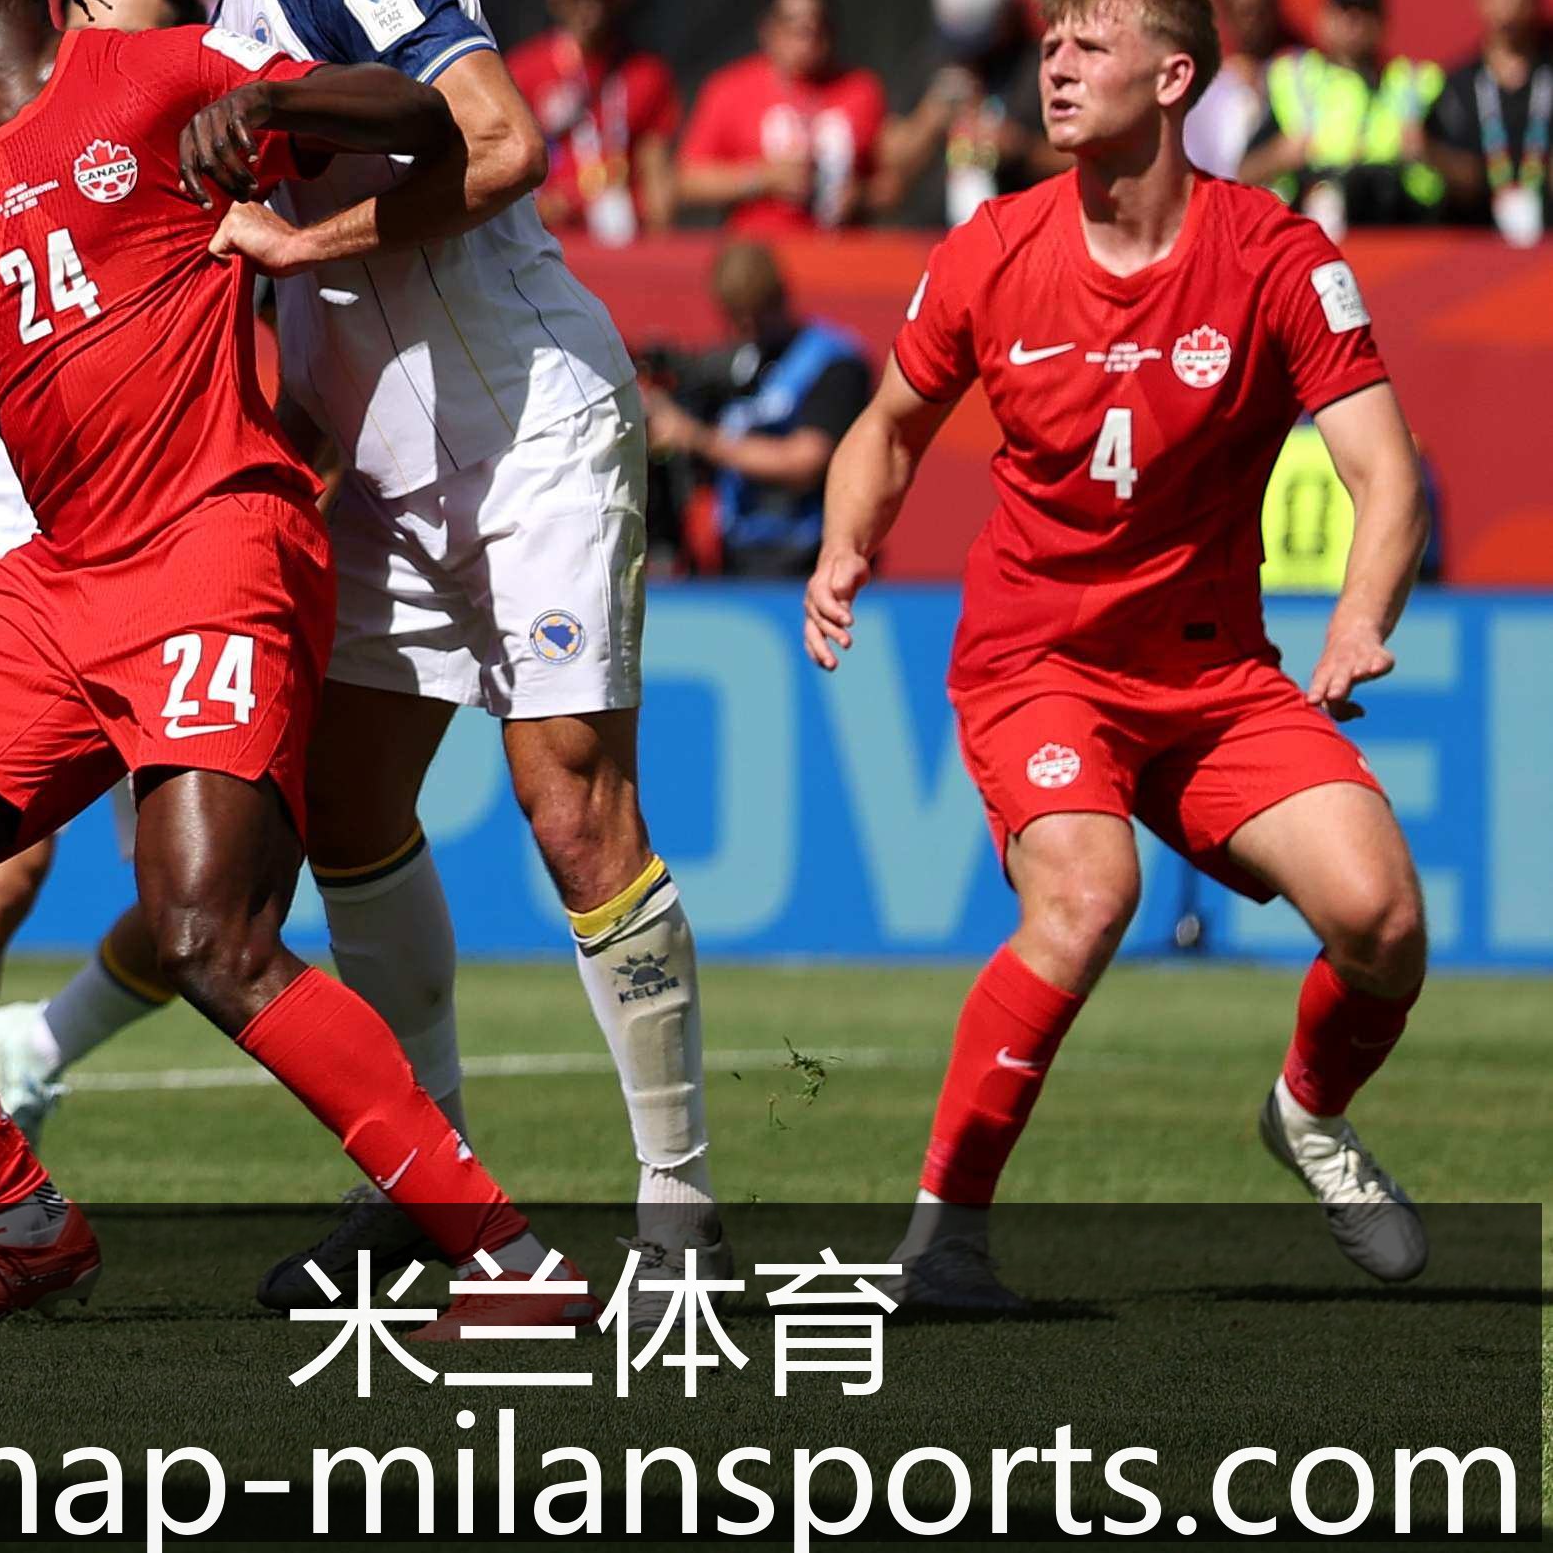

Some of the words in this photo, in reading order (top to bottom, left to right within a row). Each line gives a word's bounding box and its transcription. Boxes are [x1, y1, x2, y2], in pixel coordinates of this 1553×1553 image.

[77, 161, 136, 183] CANADA
[1089, 407, 1139, 500] 4
[160, 633, 256, 725] 24
[618, 976, 680, 1005] KELME
